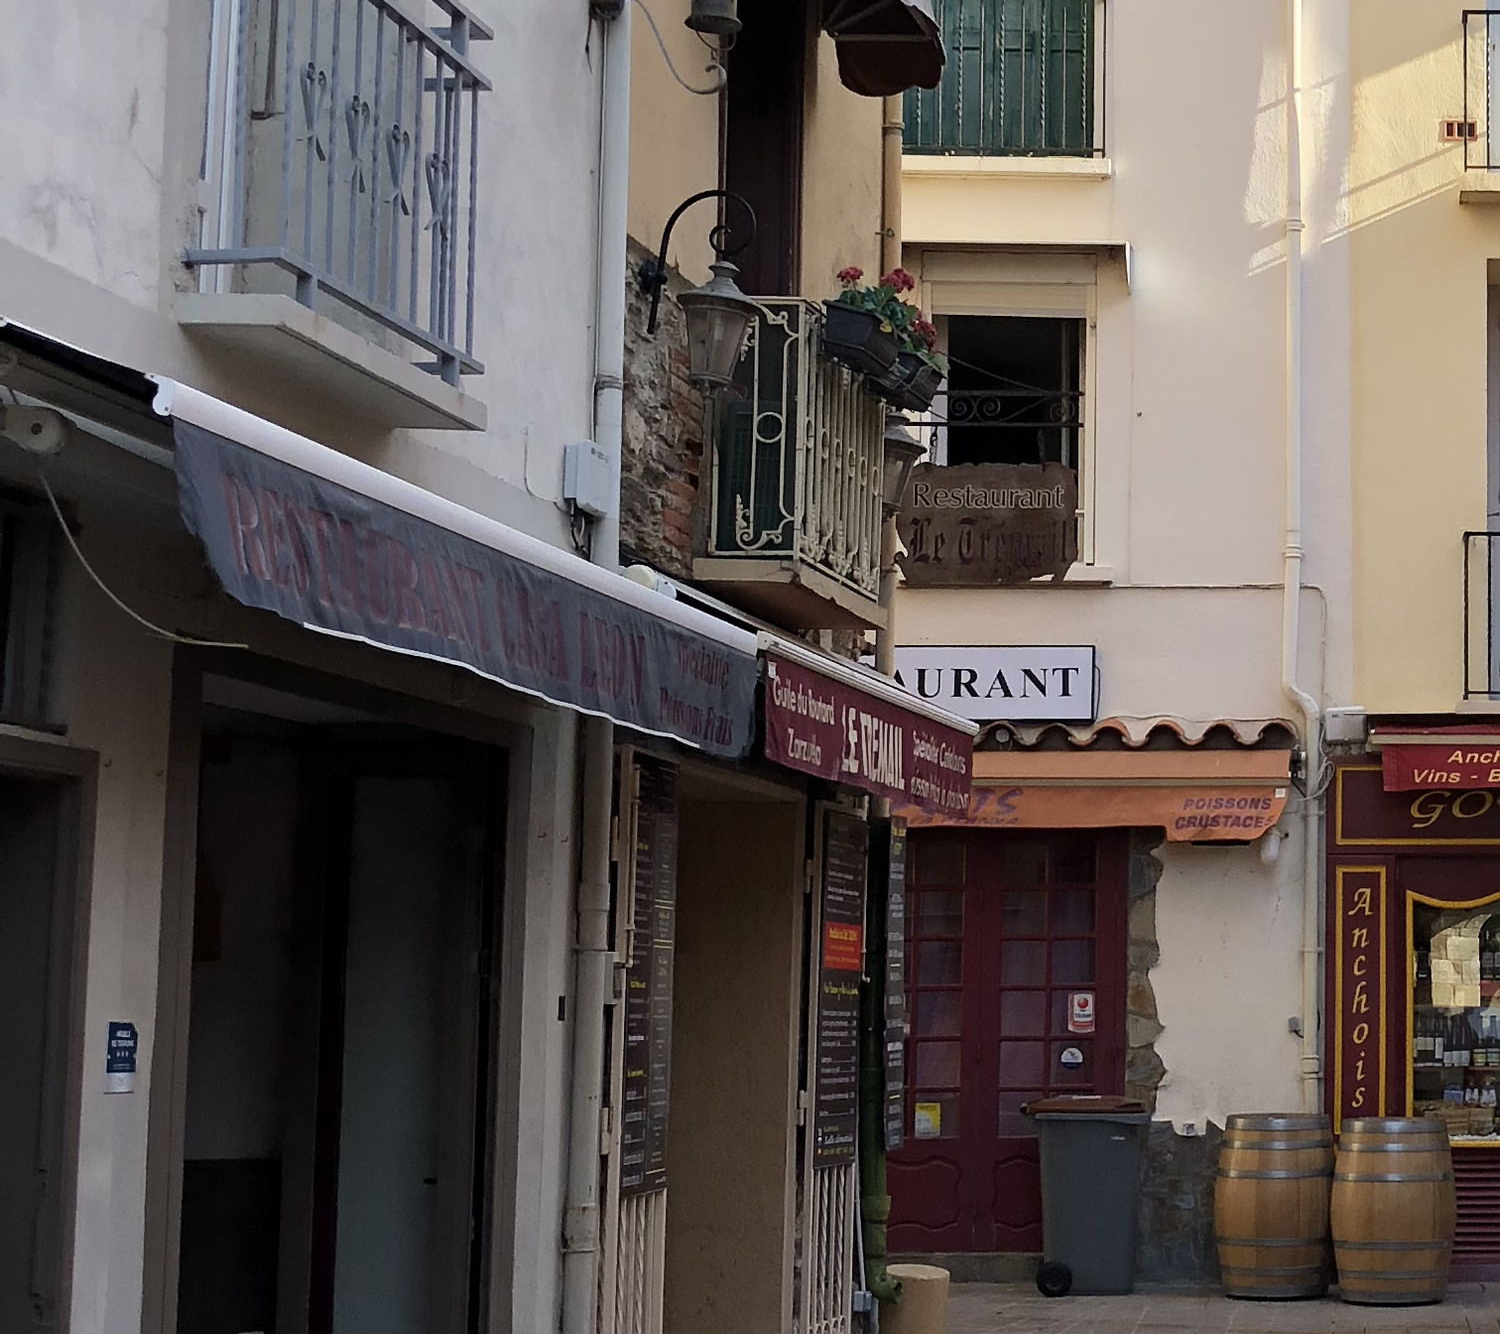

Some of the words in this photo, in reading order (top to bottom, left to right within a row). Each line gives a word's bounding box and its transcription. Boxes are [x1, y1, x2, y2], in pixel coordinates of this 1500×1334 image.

[913, 482, 1065, 509] Restaurant
[909, 517, 946, 565] Le
[1412, 769, 1461, 784] Vins
[1183, 798, 1272, 810] POISSONS
[1348, 887, 1373, 1108] Anchois
